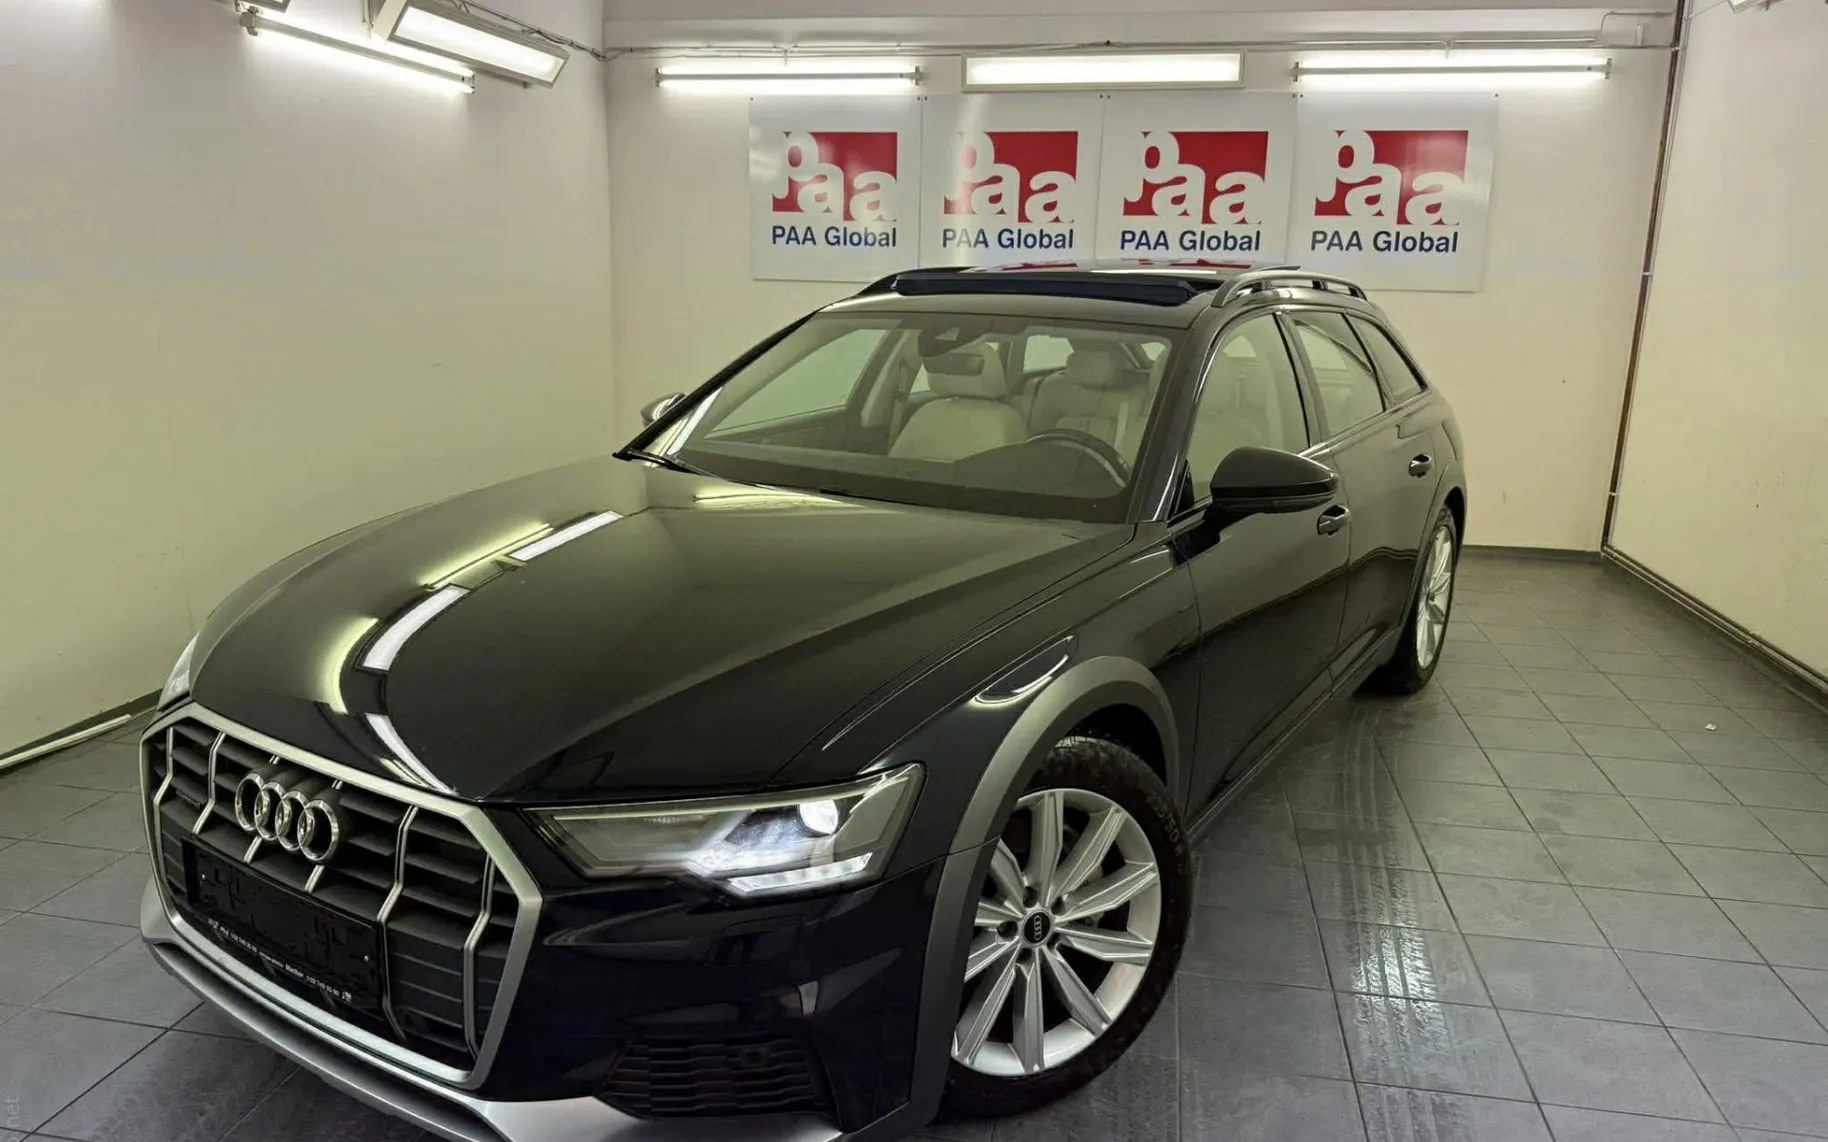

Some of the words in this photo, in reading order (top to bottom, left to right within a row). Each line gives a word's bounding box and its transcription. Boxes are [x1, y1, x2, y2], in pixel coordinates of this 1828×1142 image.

[769, 131, 898, 222] paa
[942, 131, 1077, 223] paa
[1122, 130, 1266, 225] paa
[1313, 130, 1465, 226] paa
[771, 224, 817, 246] PAA
[824, 226, 897, 248] Global
[941, 227, 989, 249] PAA
[997, 228, 1075, 249] Global
[1119, 229, 1170, 251] PAA
[1178, 230, 1261, 252] Global
[1310, 230, 1363, 252] PAA
[1372, 230, 1459, 254] Global
